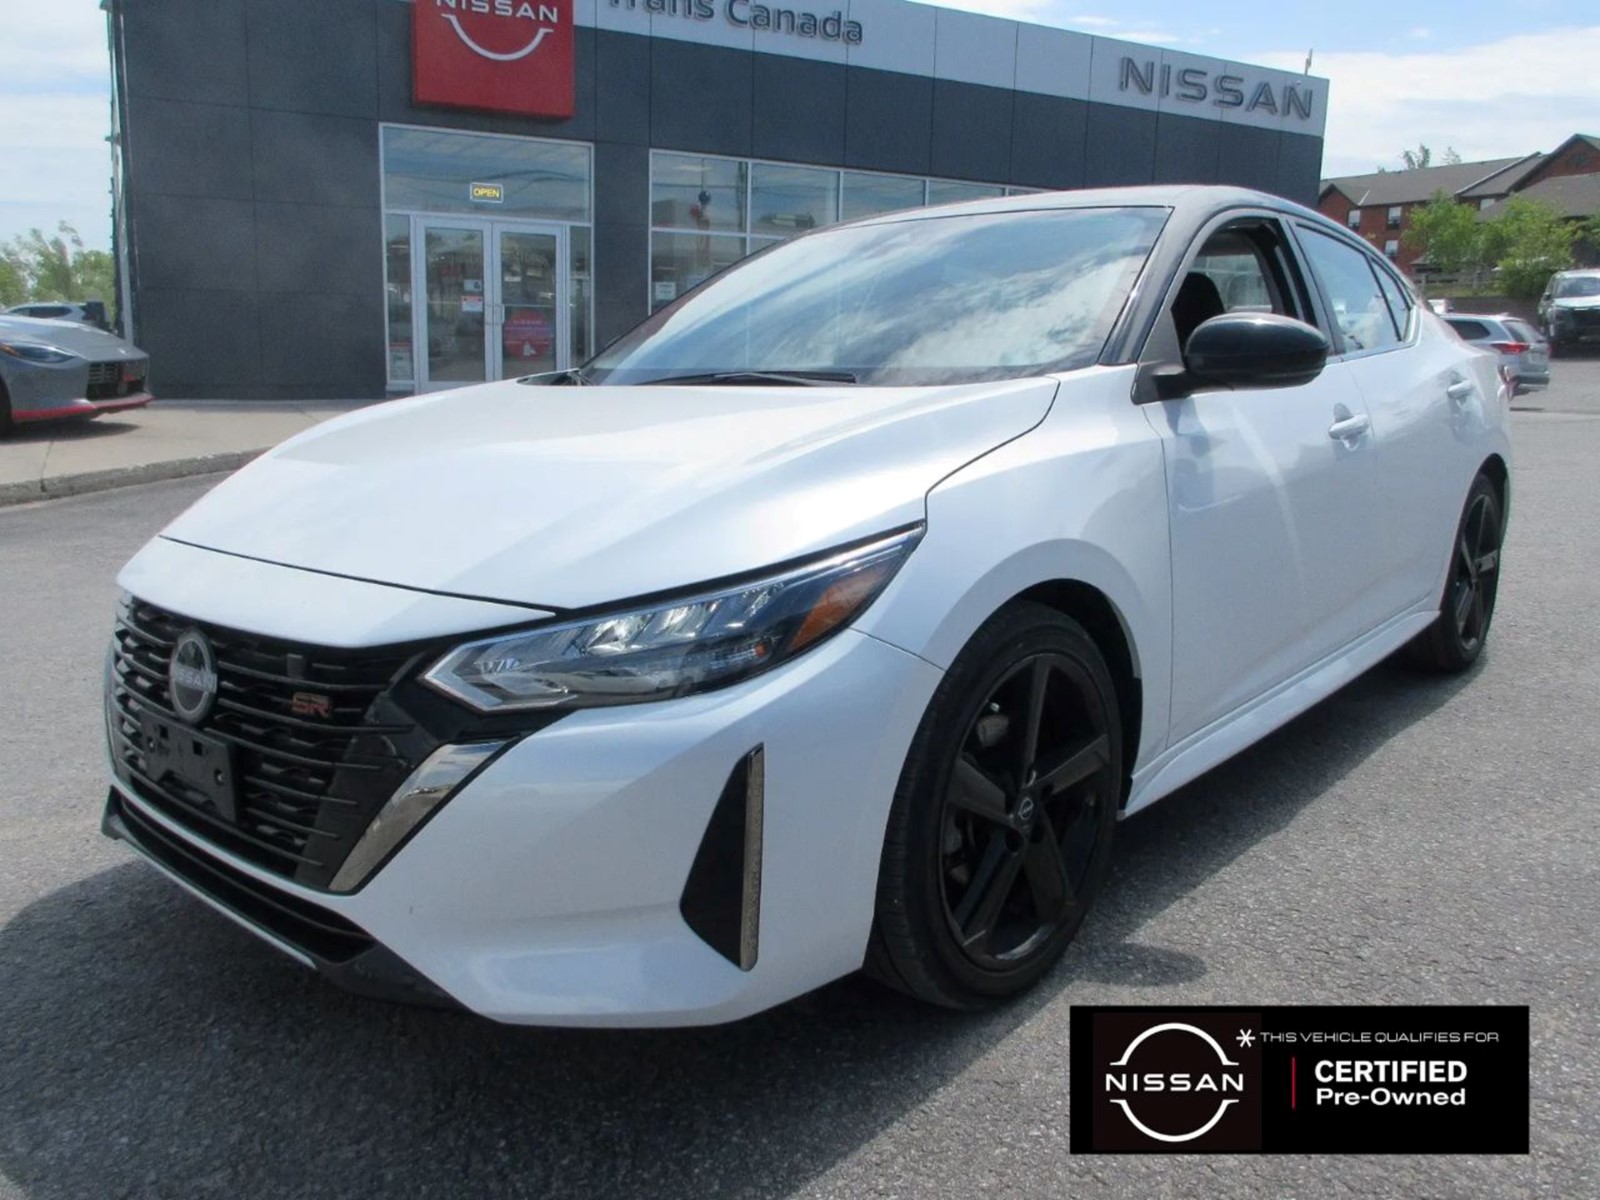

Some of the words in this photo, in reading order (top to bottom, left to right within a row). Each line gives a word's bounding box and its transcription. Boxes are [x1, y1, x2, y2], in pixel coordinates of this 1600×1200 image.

[610, 0, 715, 20] ans
[726, 0, 864, 44] Canada
[1119, 56, 1314, 120] NISSAN
[473, 187, 500, 198] OPEN
[292, 691, 330, 718] SR
